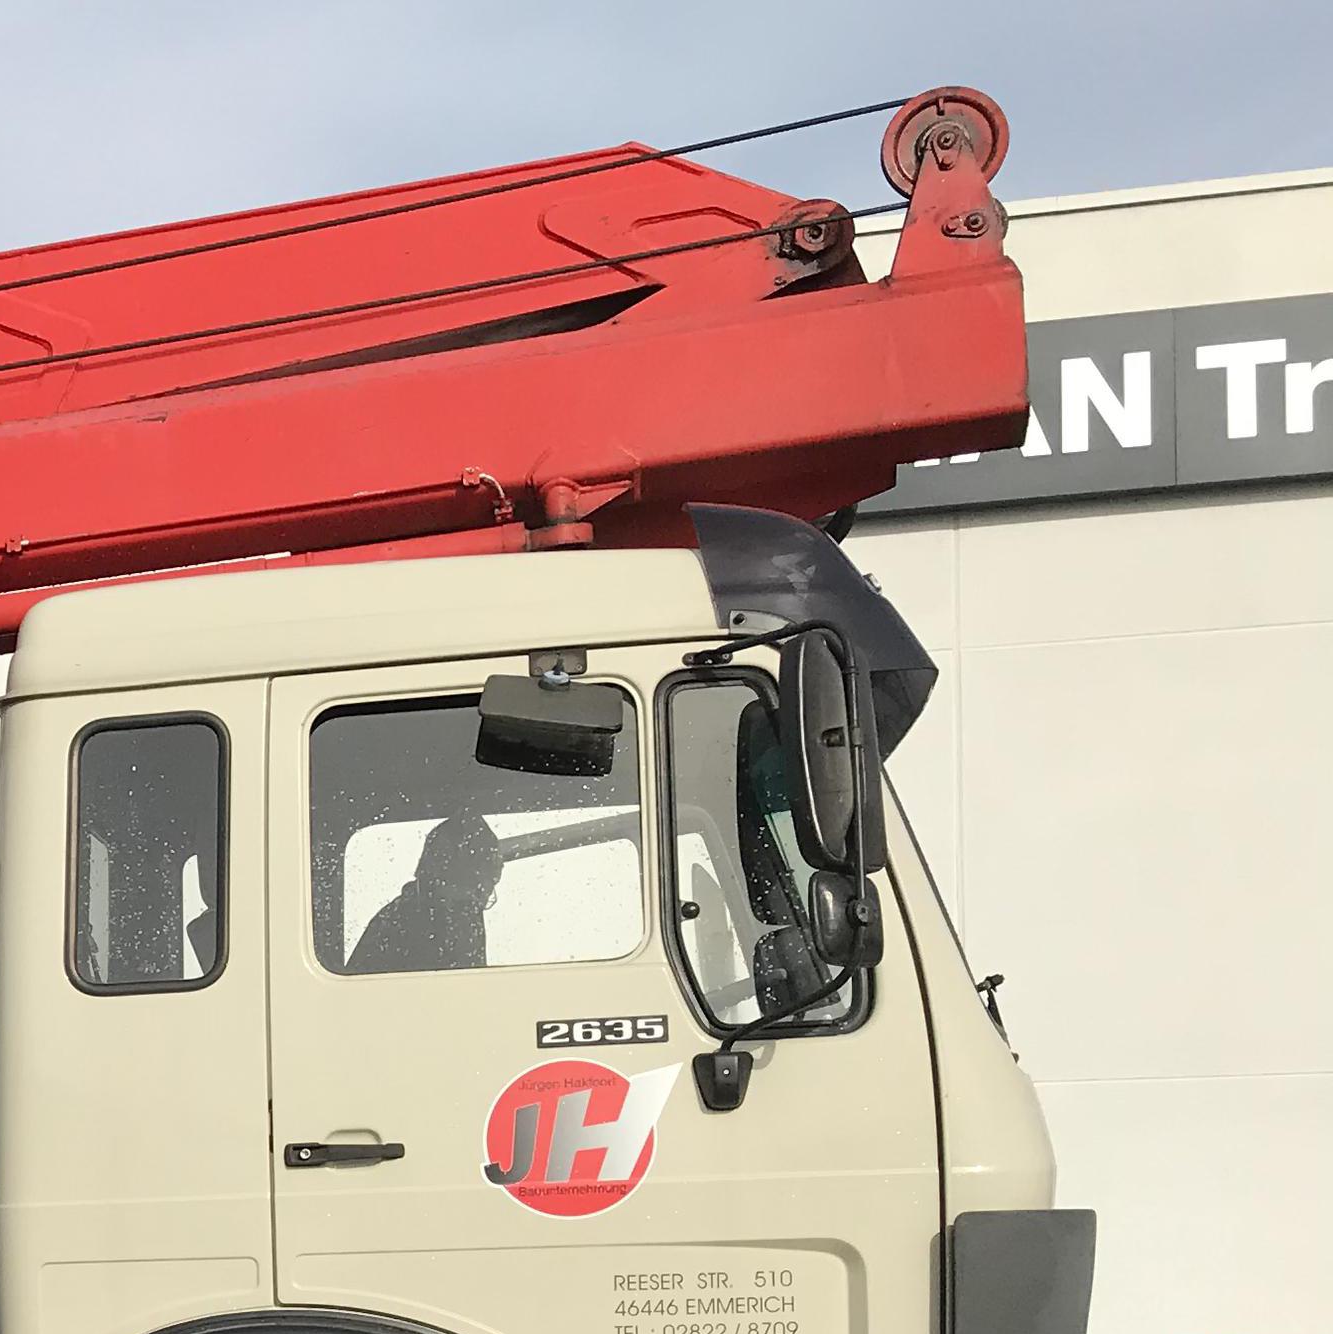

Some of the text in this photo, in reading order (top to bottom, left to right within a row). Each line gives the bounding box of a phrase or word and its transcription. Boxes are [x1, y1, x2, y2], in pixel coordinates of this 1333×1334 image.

[541, 1017, 664, 1044] 2635
[482, 1061, 684, 1187] JH
[613, 1269, 793, 1291] REESER STR. 510
[614, 1296, 795, 1317] 46446 EMMERICH
